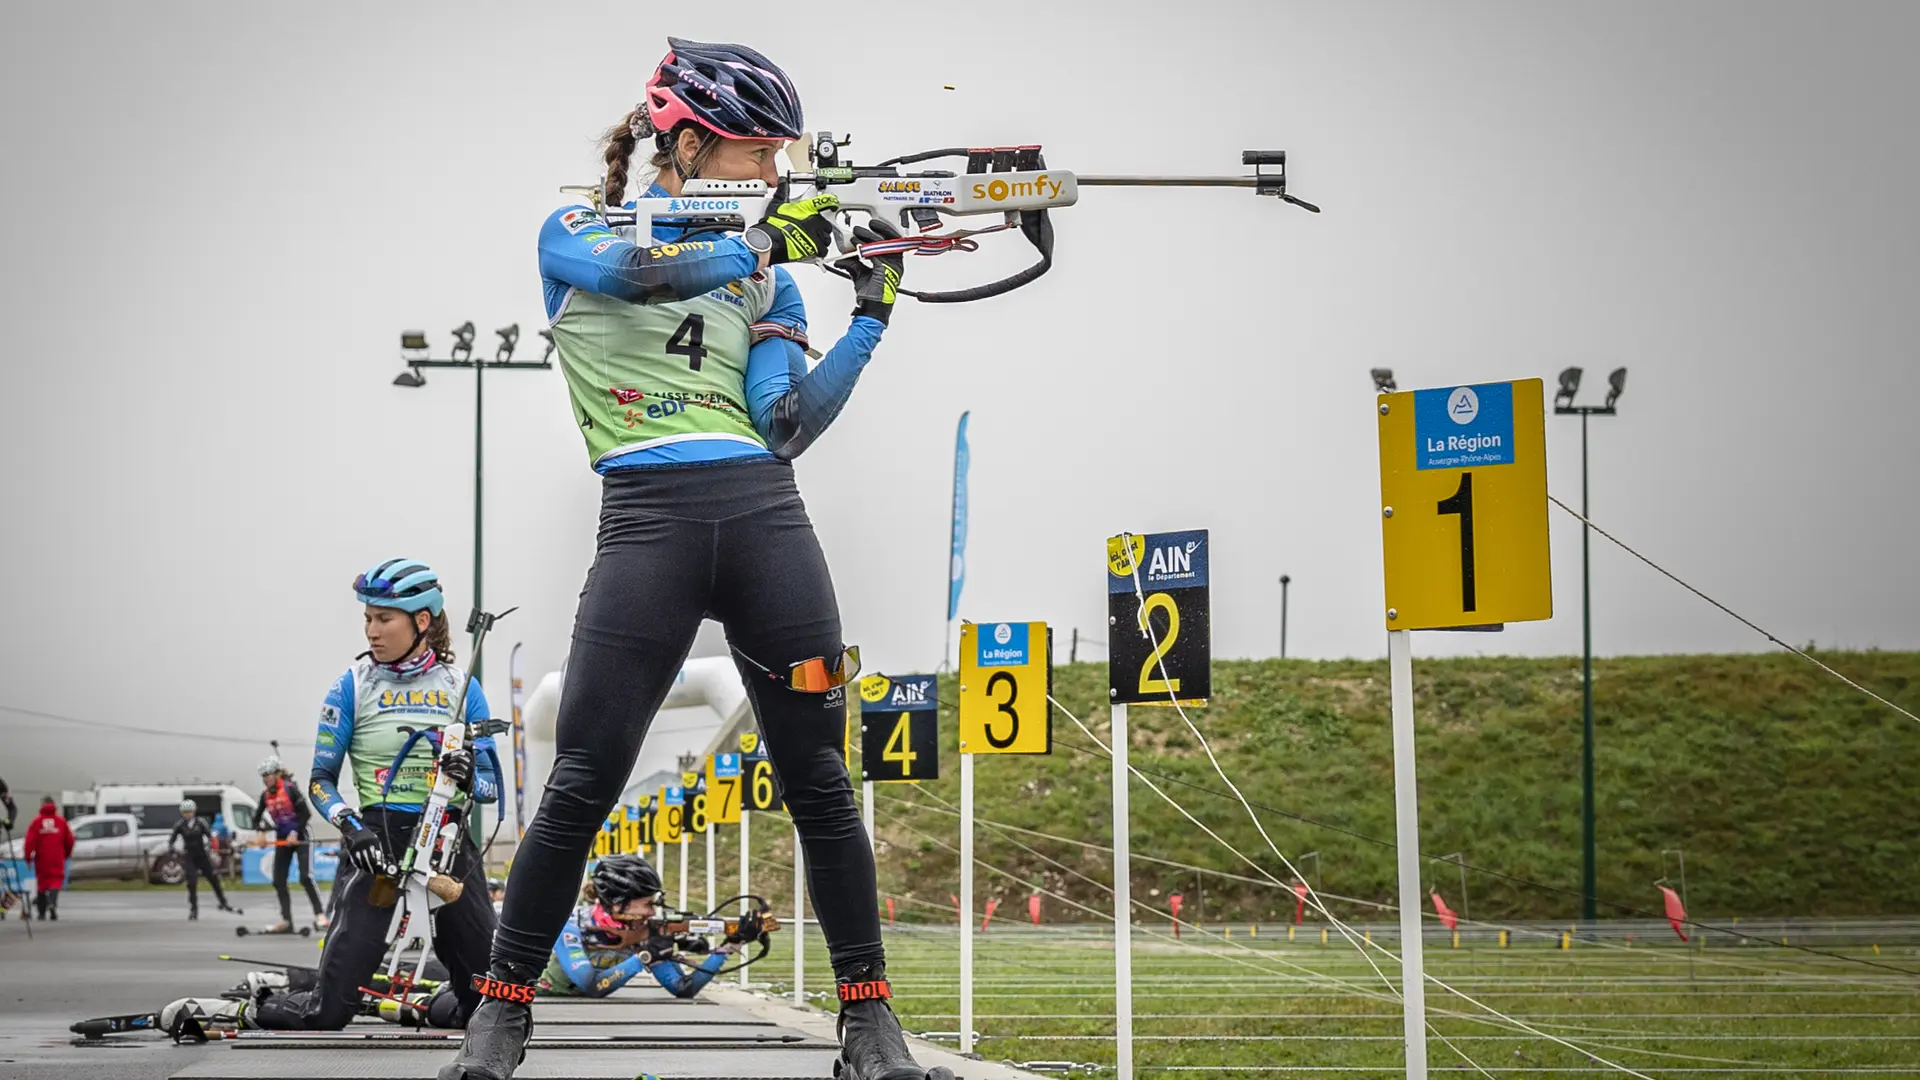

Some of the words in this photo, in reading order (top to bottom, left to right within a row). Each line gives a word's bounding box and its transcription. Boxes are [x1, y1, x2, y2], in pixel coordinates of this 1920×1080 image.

[878, 181, 921, 193] SAMSE
[972, 174, 1063, 201] somfy
[681, 199, 739, 210] Vercors
[666, 312, 708, 372] 4
[581, 407, 594, 430] 4
[1427, 437, 1445, 453] La
[1447, 432, 1502, 453] Région
[1437, 472, 1476, 613] 1
[1148, 546, 1191, 575] AIN
[1156, 571, 1195, 580] Département
[983, 650, 993, 659] La
[994, 648, 1022, 660] Région
[1137, 593, 1180, 693] 2
[378, 689, 449, 708] SAMSE
[984, 671, 1019, 749] 3
[883, 711, 917, 776] 4
[718, 780, 735, 819] 7
[753, 760, 773, 809] 6
[668, 806, 681, 840] 9
[692, 794, 708, 833] 8
